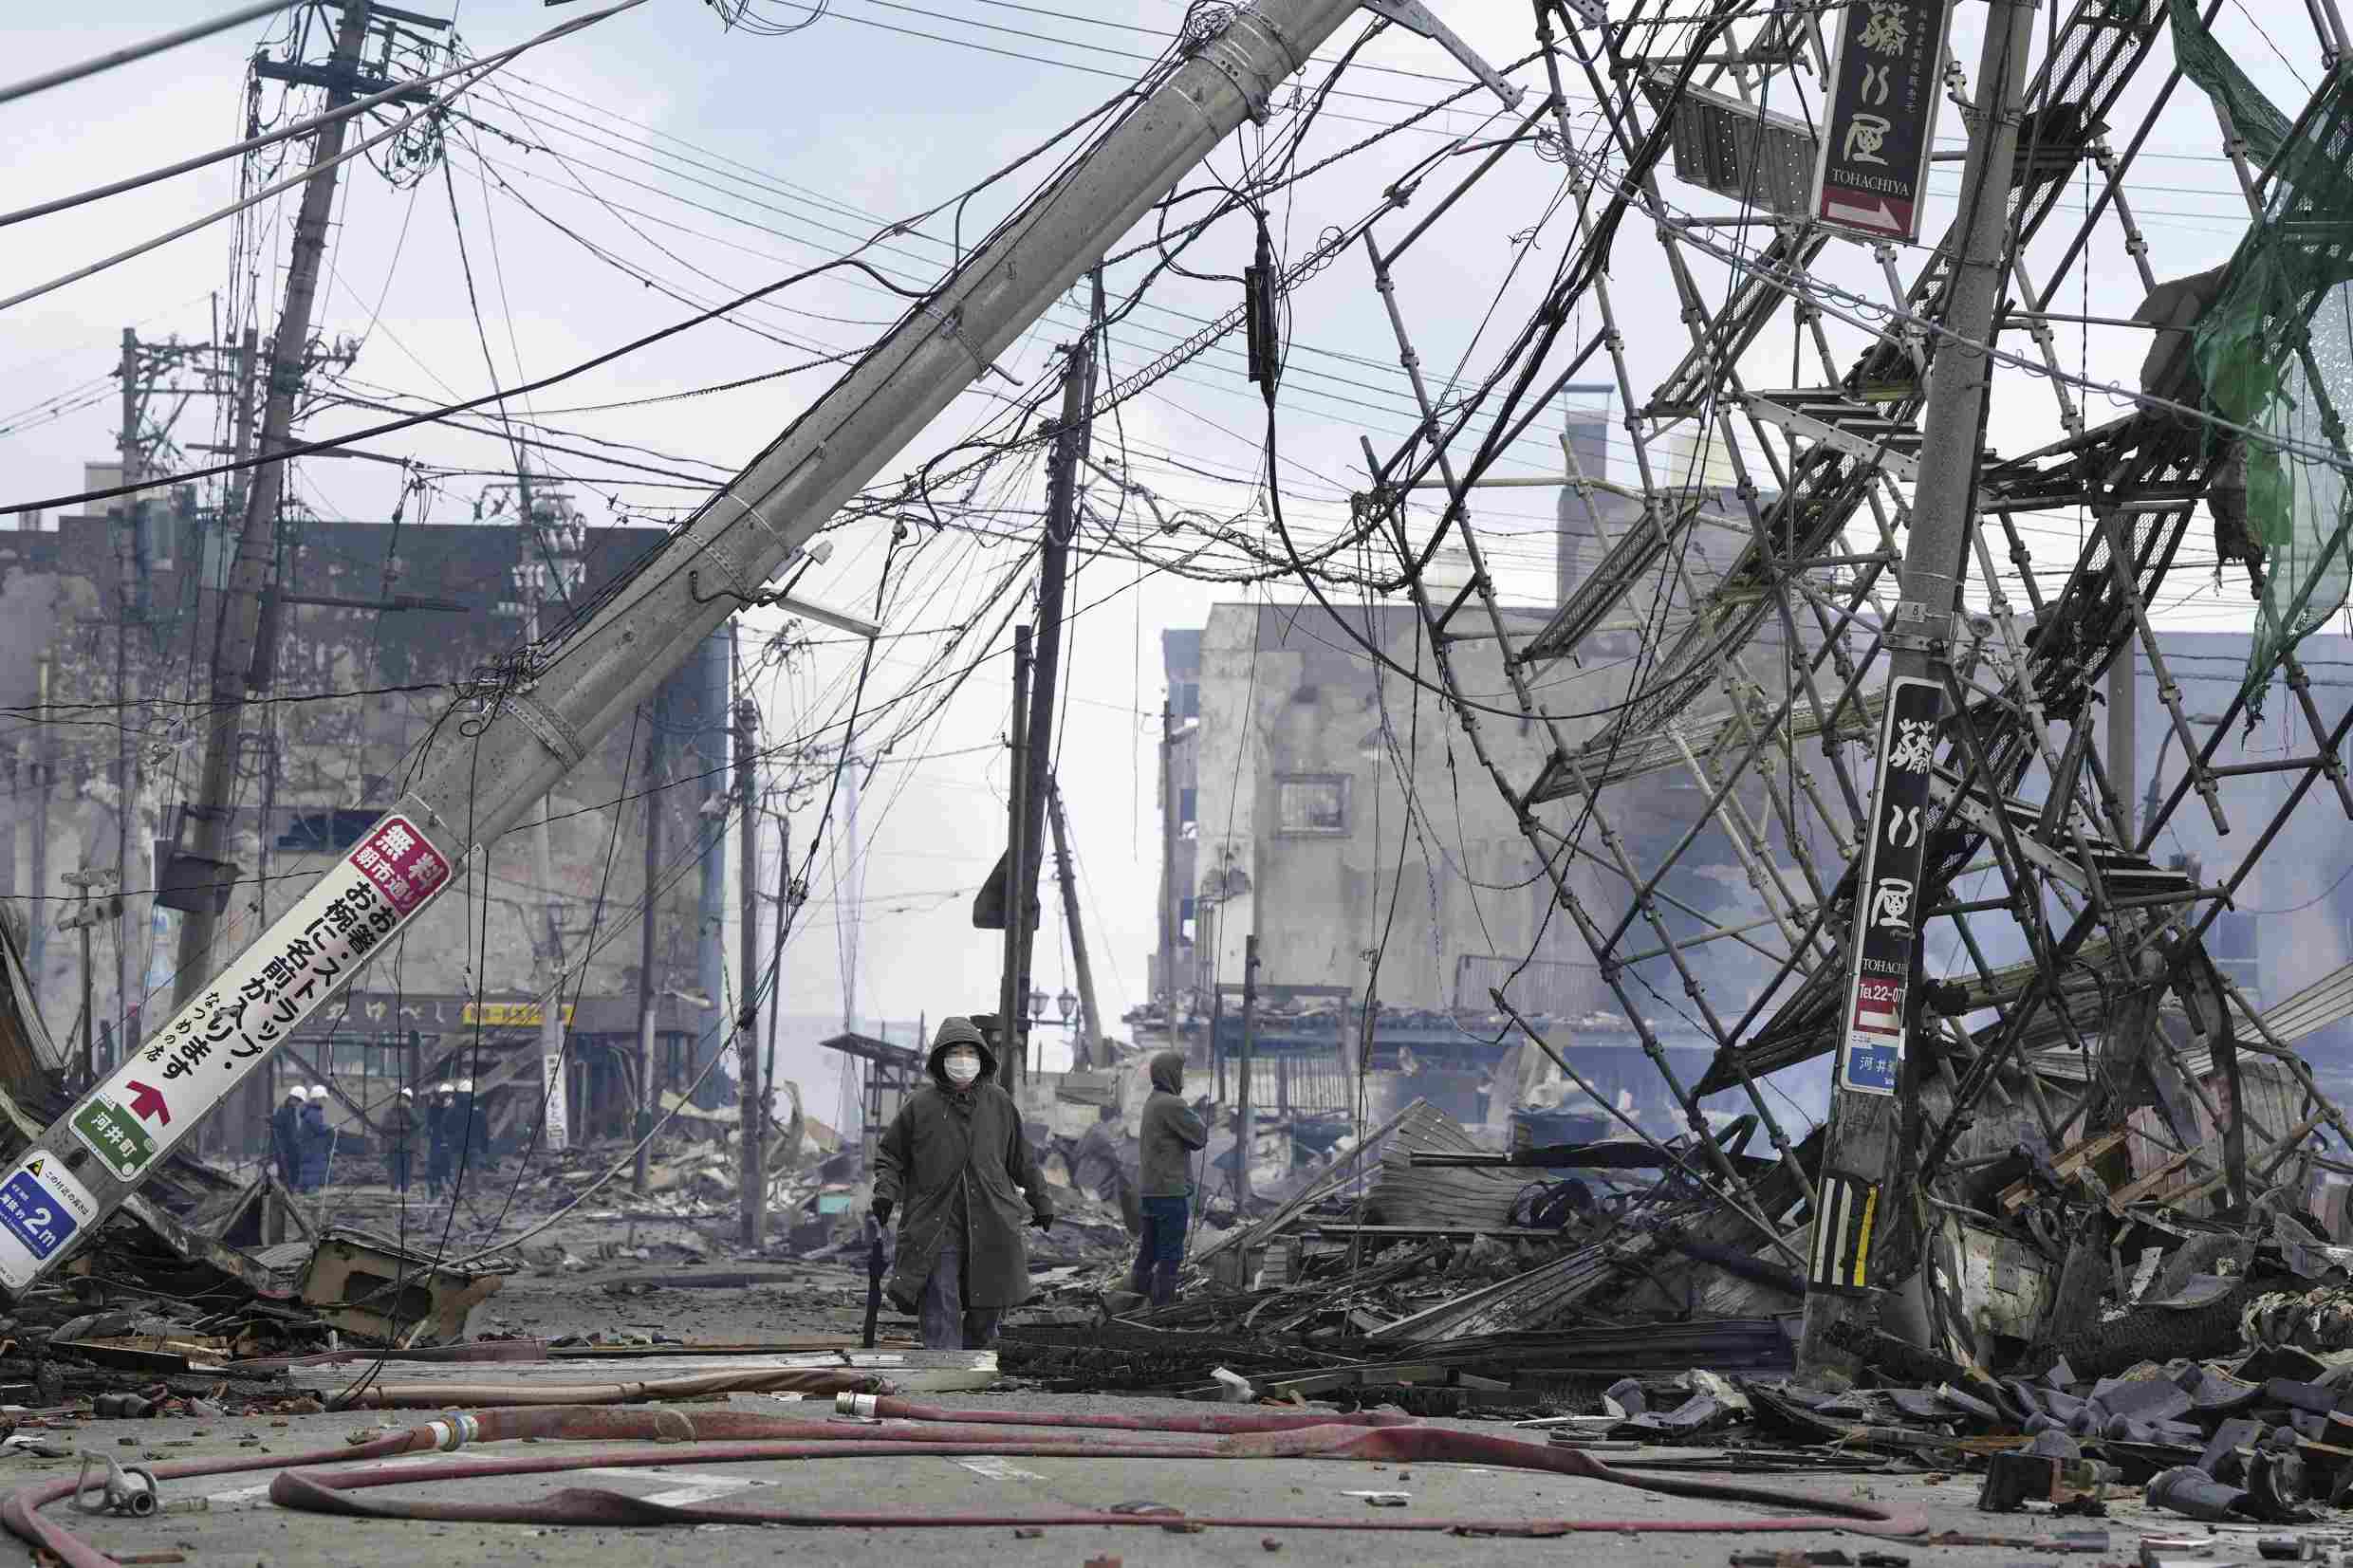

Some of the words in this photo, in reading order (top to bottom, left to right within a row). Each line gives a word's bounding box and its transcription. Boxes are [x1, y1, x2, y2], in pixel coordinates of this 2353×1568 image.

[1832, 168, 1909, 196] TOHACHIYA
[375, 824, 443, 888] 無料
[144, 992, 220, 1062] なつめの店
[91, 1112, 138, 1158] 河井町
